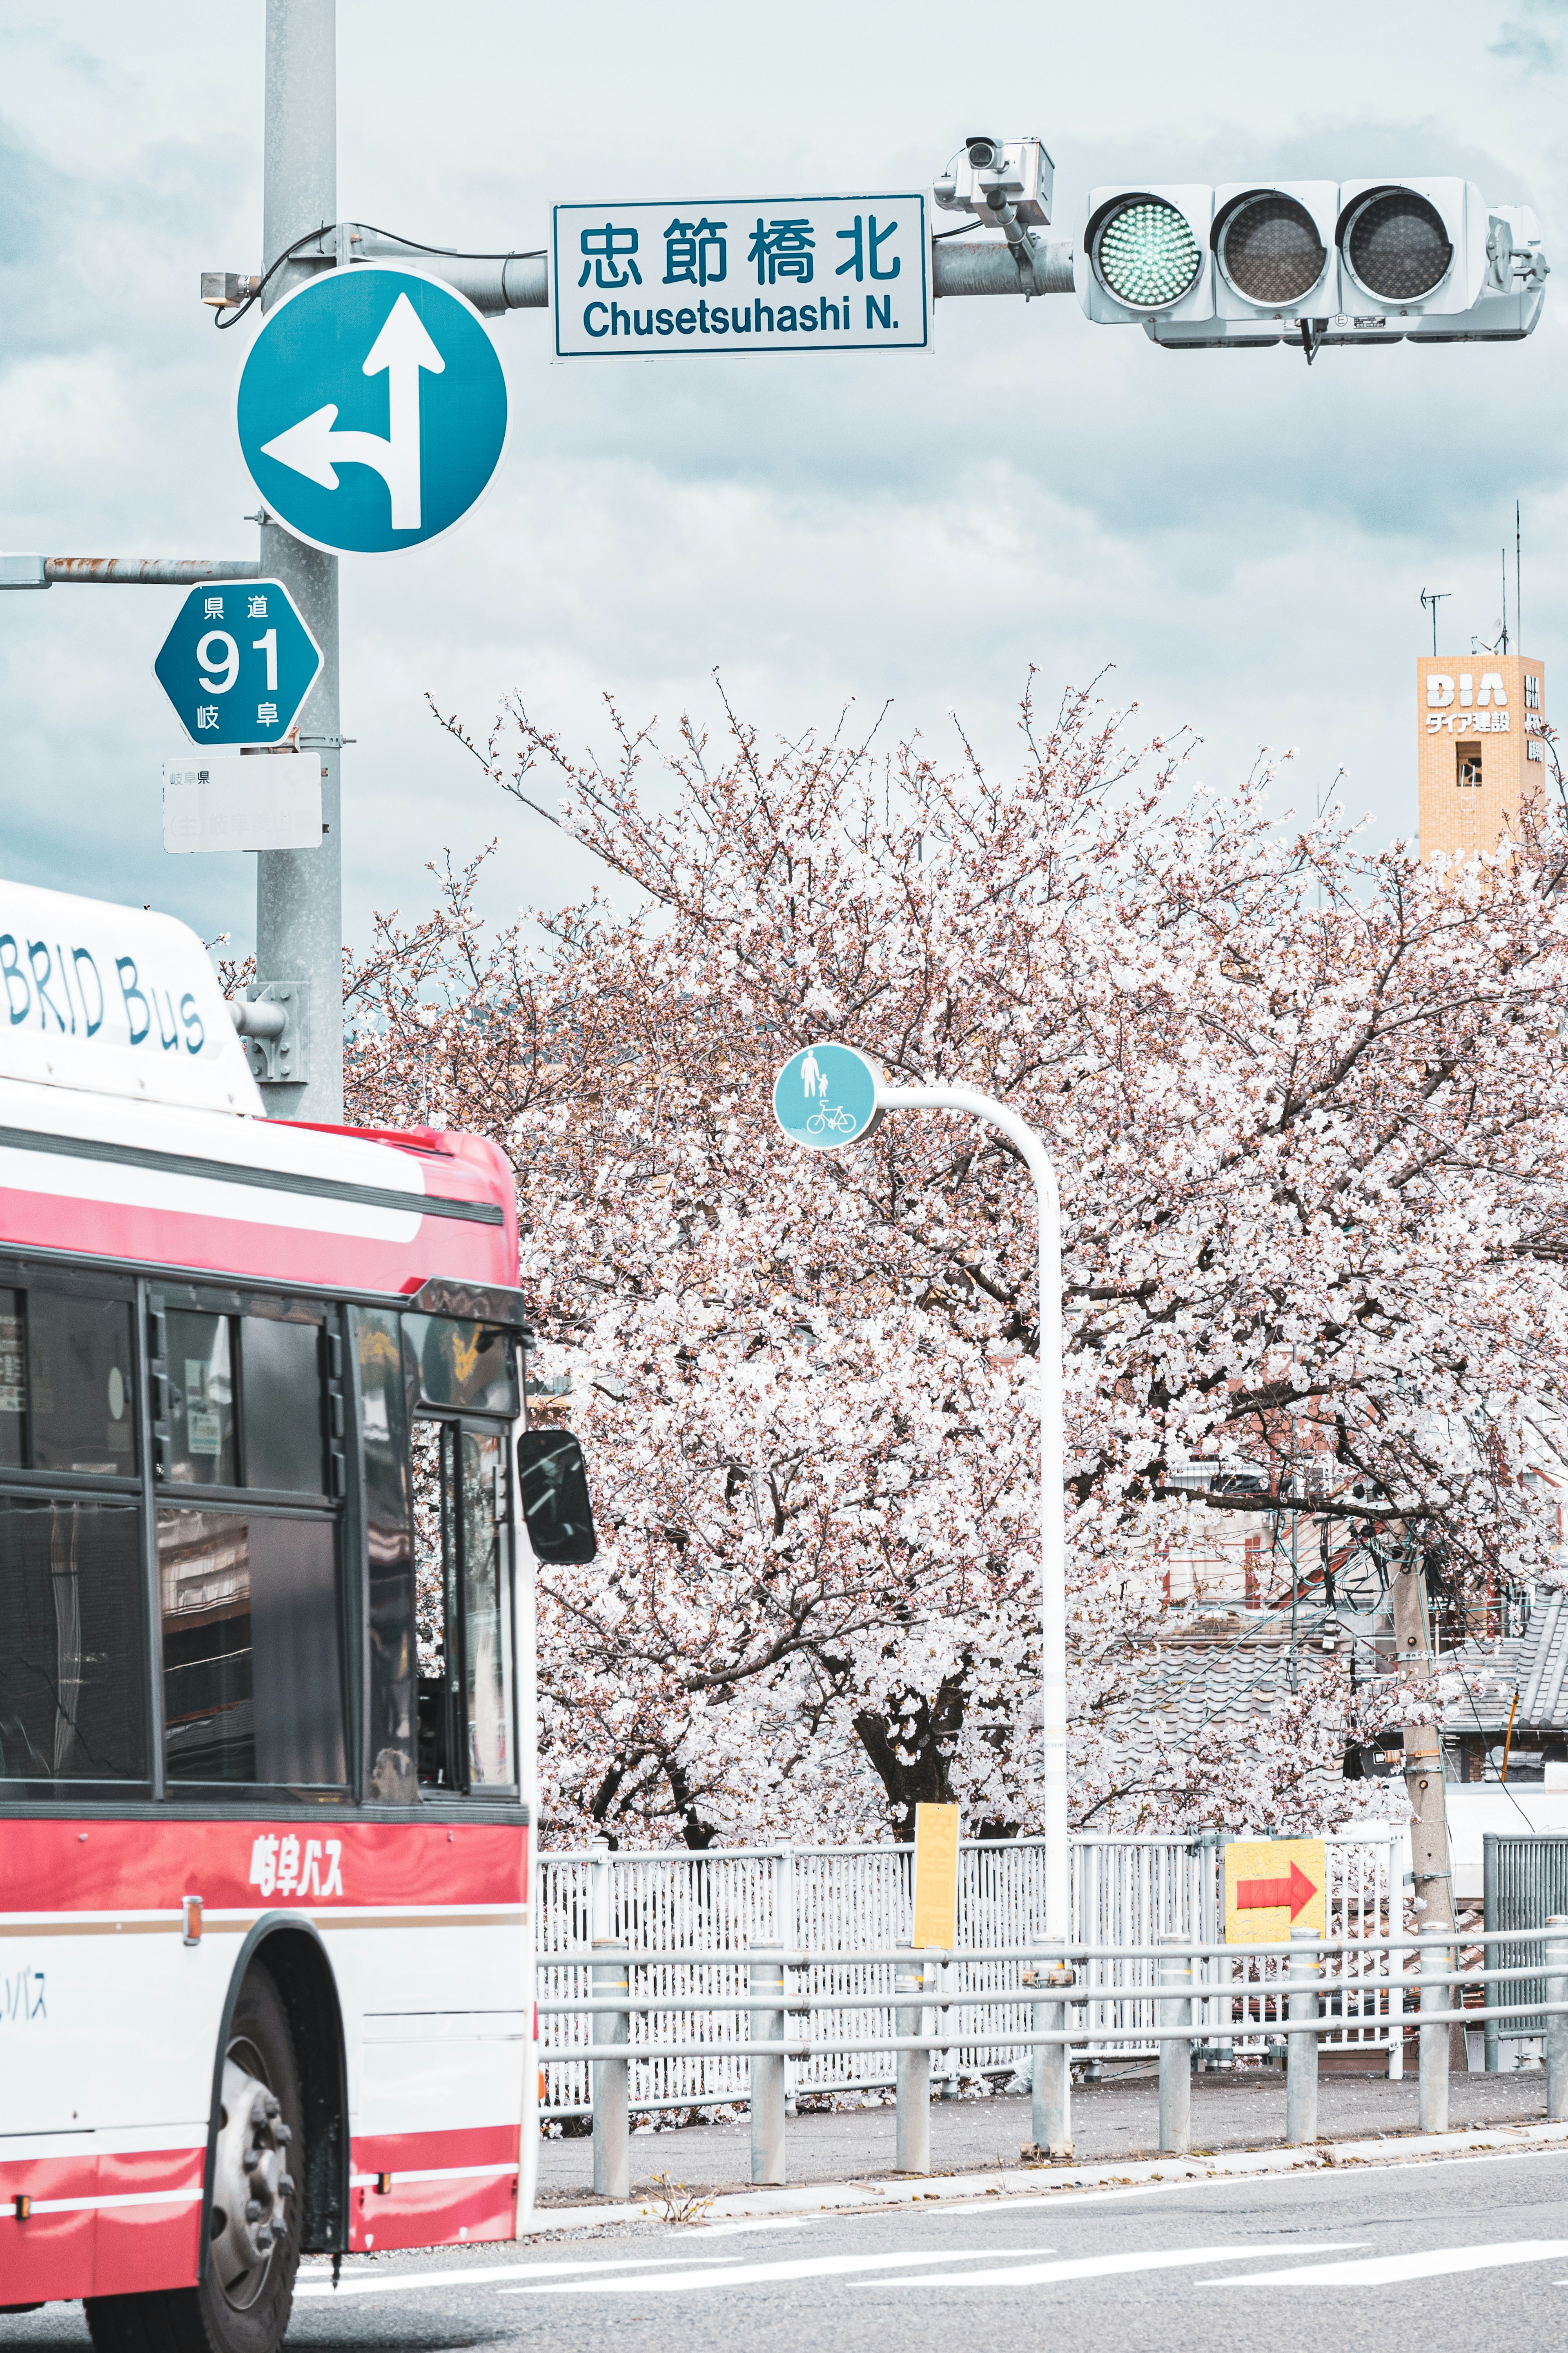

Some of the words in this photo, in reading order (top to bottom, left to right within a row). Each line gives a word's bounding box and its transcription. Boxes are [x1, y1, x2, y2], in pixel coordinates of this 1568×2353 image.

[578, 214, 901, 288] 忠節橋北
[583, 296, 850, 337] Chusetsuhashi
[866, 295, 899, 328] N.
[204, 595, 269, 620] 県道
[196, 628, 278, 694] 91
[1426, 672, 1508, 707] DIA
[197, 701, 279, 729] 岐阜
[1425, 711, 1510, 734] ダイア建設
[170, 770, 210, 785] 岐阜県
[0, 934, 104, 1038] BRID
[115, 956, 205, 1055] Bus
[249, 1833, 344, 1897] 岐阜バス
[919, 1812, 952, 1940] 安全運転
